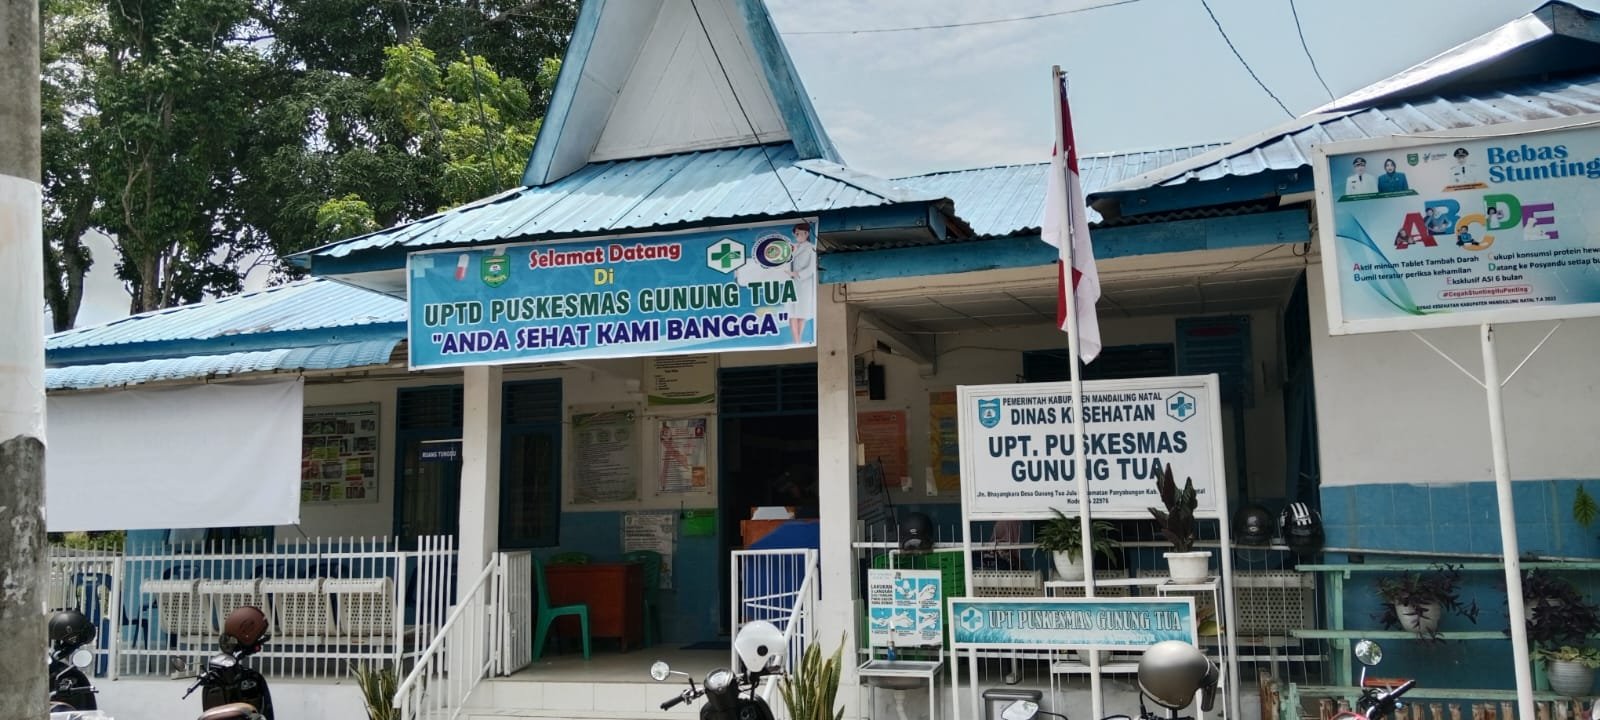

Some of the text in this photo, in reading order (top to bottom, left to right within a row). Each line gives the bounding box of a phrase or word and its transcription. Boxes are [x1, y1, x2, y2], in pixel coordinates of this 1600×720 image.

[1487, 144, 1568, 165] Bebas
[1489, 157, 1600, 183] Stunting
[1394, 193, 1559, 251] ABCDE
[529, 243, 681, 269] Selamat Datang
[1517, 250, 1551, 258] konsumsi
[1553, 248, 1581, 256] protein
[1353, 263, 1372, 271] Aktif
[1374, 262, 1399, 270] minum
[1401, 260, 1424, 268] Tablet
[1426, 258, 1455, 266] Tambah
[1354, 273, 1377, 282] Bumil
[1405, 270, 1432, 279] periksa
[1433, 267, 1472, 275] kehamilan
[1488, 263, 1517, 272] Datang
[1530, 259, 1566, 268] Posyandu
[1567, 258, 1591, 266] setiap
[594, 268, 613, 285] Di
[1446, 275, 1480, 285] Eksklusif
[1502, 273, 1523, 281] bulan
[425, 280, 797, 327] UPTD PUSKESMAS GUNUNG TUA
[433, 313, 789, 354] "ANDA SEHAT KAMI BANGGA"
[1003, 391, 1163, 406] PEMERINTAH KABUPEN MANDAILING NATAL
[1011, 408, 1056, 425] DINAS
[988, 431, 1188, 458] UPT. PUSKESMAS
[1117, 457, 1163, 480] TUA
[988, 610, 1182, 632] UPT PUSKESMAS GUNUNG TUA
